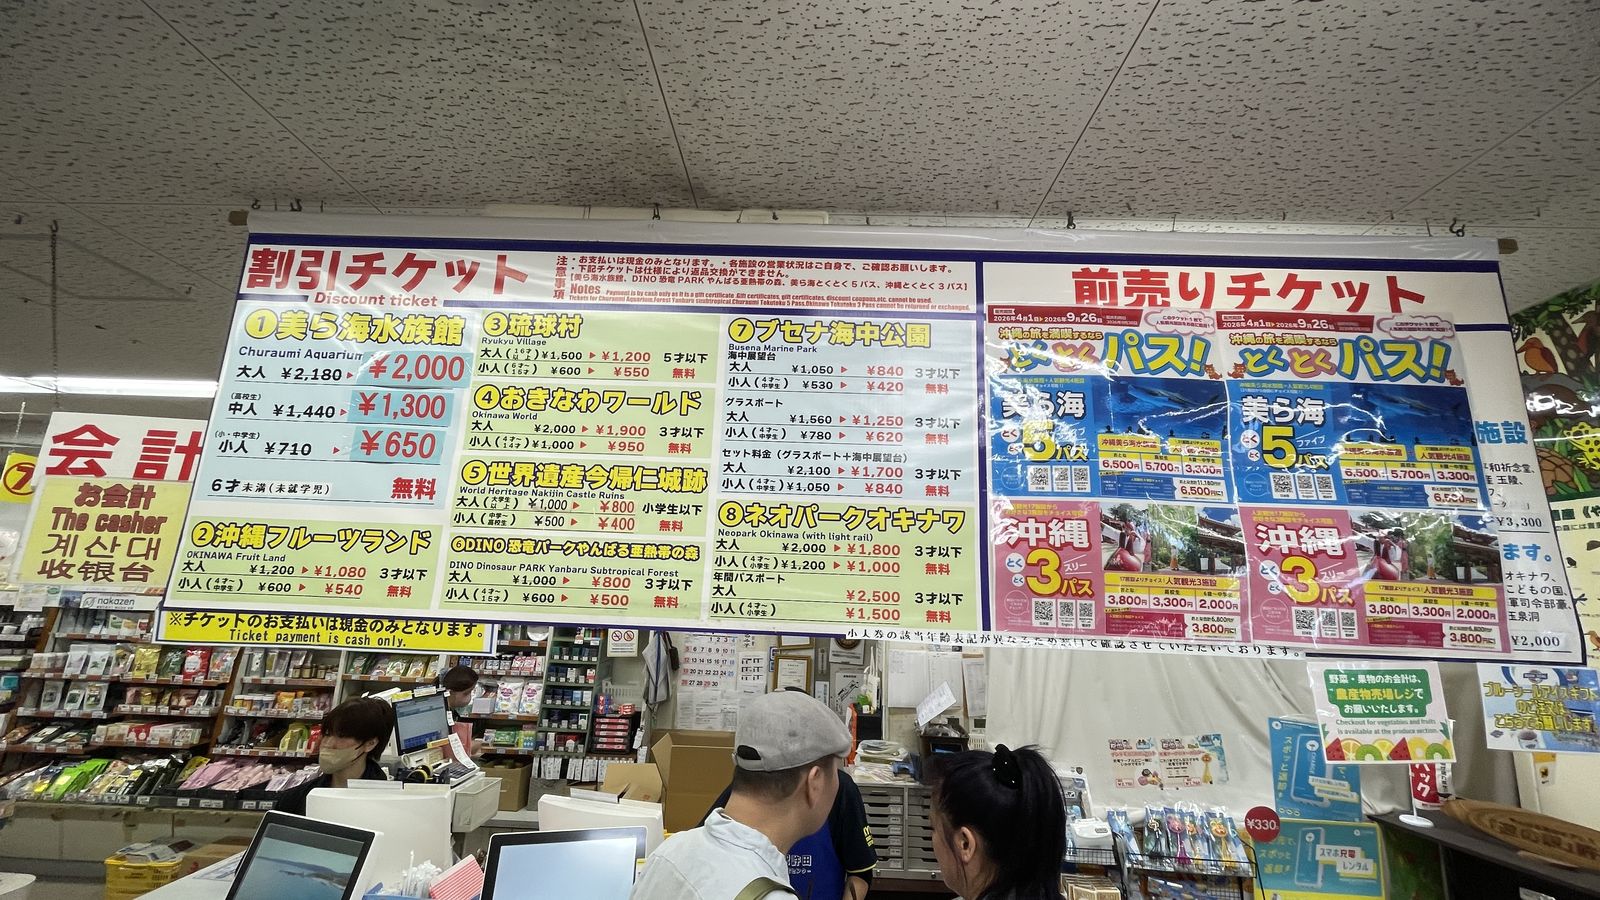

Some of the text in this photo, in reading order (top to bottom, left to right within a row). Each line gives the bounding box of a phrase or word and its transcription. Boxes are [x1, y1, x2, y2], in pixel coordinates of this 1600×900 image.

[246, 247, 528, 294] 割引チケット
[632, 275, 703, 284] DINO PARK
[571, 283, 600, 294] Notes
[1072, 267, 1425, 313] 前売りチケット
[314, 292, 437, 307] Discount ticket
[482, 338, 513, 346] Ryukyu
[239, 346, 301, 358] Churaumi
[542, 351, 708, 364] ¥1,500 5才以下
[728, 351, 776, 360] 海中展望台
[236, 354, 464, 382] 大人 ¥2,180 ¥2,000
[614, 367, 695, 379] ¥550 無料
[867, 365, 960, 379] ¥840 3才以下
[867, 381, 904, 392] ¥420
[228, 392, 446, 419] 中人 ¥1,440 ¥1,300
[726, 398, 782, 407] グラスボート
[472, 411, 509, 419] Okinawa
[1241, 395, 1325, 426] 美ら海
[853, 416, 903, 426] ¥1,250
[471, 421, 704, 438] 大人 ¥1,900 3才以下
[1475, 420, 1528, 444] 施設
[219, 430, 436, 458] 小人 ¥710 ¥650
[866, 432, 902, 442] ¥620
[46, 424, 203, 481] 会計
[532, 440, 691, 454] ¥1,000 ¥950 無料
[723, 448, 771, 459] セット料金
[1262, 425, 1297, 469] 5
[1103, 460, 1139, 469] 6,500円
[851, 466, 903, 478] ¥1,700
[1391, 470, 1475, 480] 5,700円 3,300円
[74, 483, 156, 509] お会計
[391, 478, 436, 500] 無料
[488, 488, 528, 497] Heritage
[532, 489, 563, 498] Nakijin
[567, 490, 596, 498] Castle
[599, 491, 624, 499] Ruins
[600, 501, 702, 516] ¥800 小学生以下
[52, 507, 167, 534] The casher
[535, 515, 683, 531] ¥500 ¥400 無料
[1497, 516, 1542, 528] ¥3,300
[718, 529, 873, 542] Neopark Okinawa (with light rail)
[1005, 517, 1091, 549] 沖縄
[1256, 524, 1344, 556] 沖縄
[42, 533, 161, 561] 계산대
[847, 544, 900, 556] ¥1,800
[1503, 543, 1552, 562] ます。
[187, 551, 285, 562] OKINAWA Fruit Land
[37, 559, 154, 583] 收银台
[182, 562, 427, 581] 大人 ¥1,200 ¥1,080 3才以下
[450, 561, 678, 577] DINO Dinosaur PARK Yanbaru Subtropical Forest
[1026, 548, 1061, 596] 3
[645, 578, 693, 591] 3才以下
[1282, 555, 1320, 603] 3
[258, 583, 411, 597] ¥600 ¥540 無料
[847, 590, 900, 603] ¥2,500
[1507, 585, 1567, 596] こどもの国、
[97, 597, 135, 606] nakazen
[1108, 595, 1238, 610] 3,800円 3,300円 2,000円
[1369, 604, 1495, 619] 3,800円 3,300円 2,000円
[1509, 611, 1540, 622] 玉泉洞
[230, 629, 406, 647] Ticket payment is cash only.
[1512, 635, 1560, 647] ¥2,000
[1246, 819, 1276, 831] ¥330
[1320, 848, 1356, 859] スマホ充電
[1342, 862, 1368, 871] レンタル
